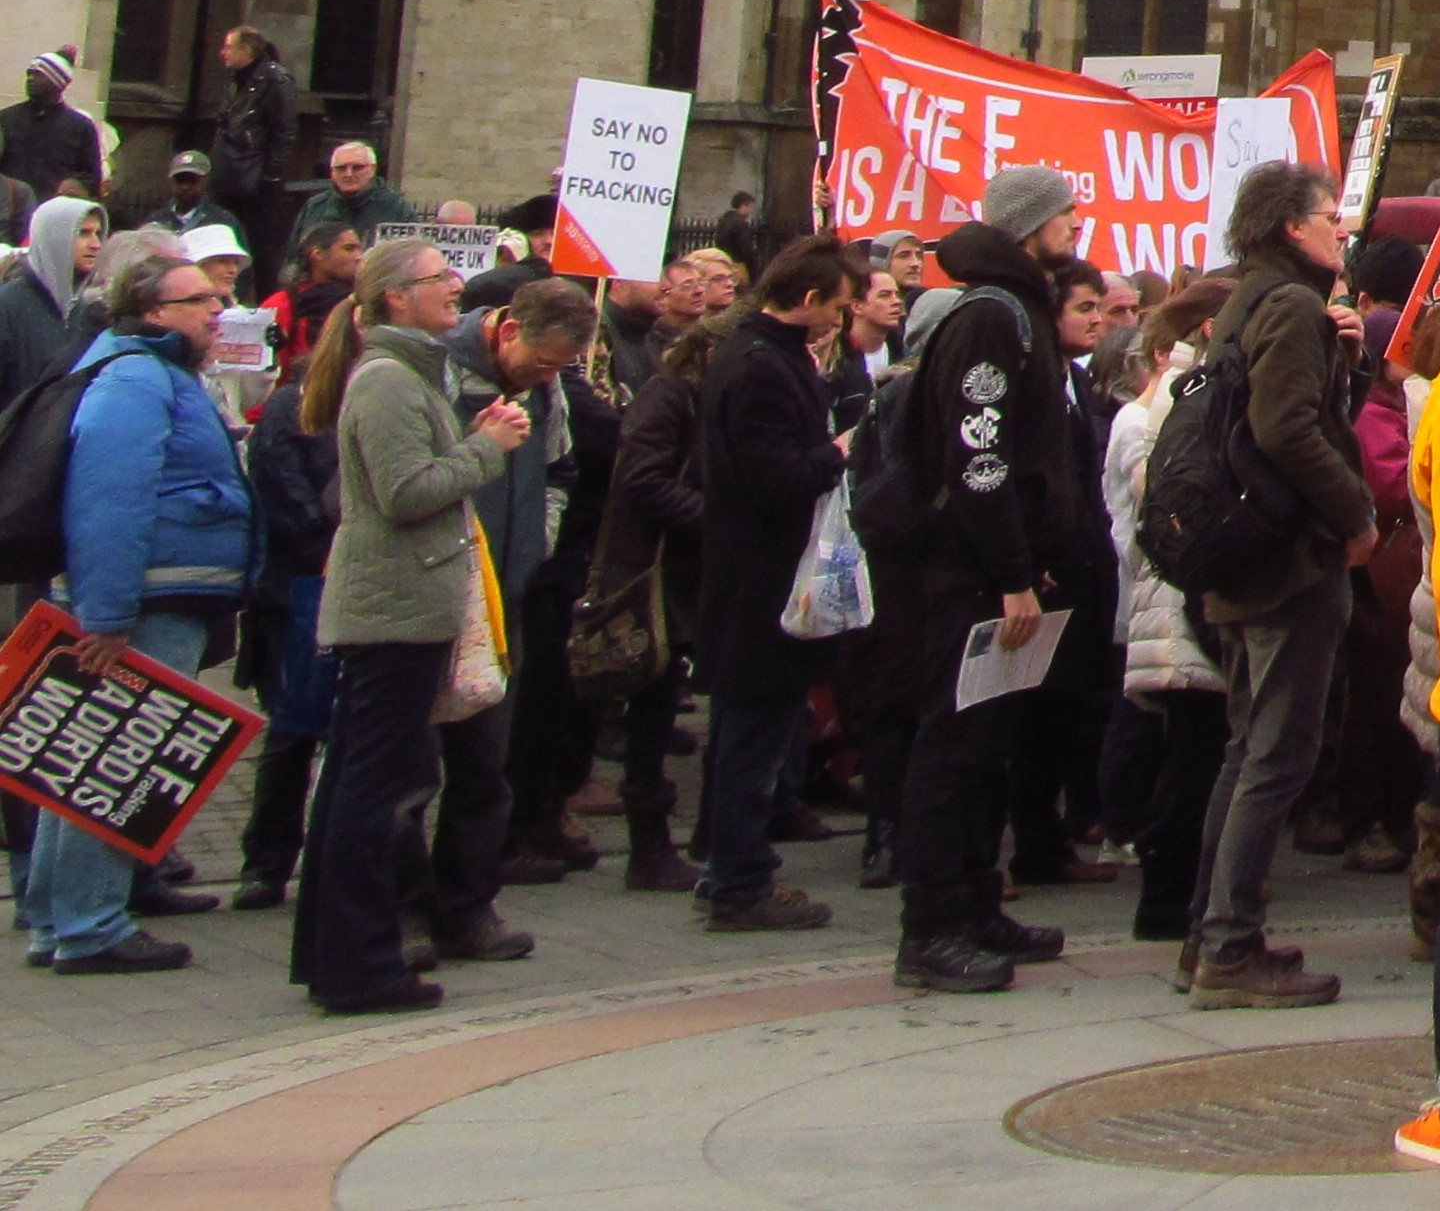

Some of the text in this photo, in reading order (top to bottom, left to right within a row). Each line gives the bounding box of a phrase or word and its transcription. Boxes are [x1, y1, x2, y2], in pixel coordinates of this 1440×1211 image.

[591, 117, 668, 146] SAY NO
[881, 77, 966, 173] THE
[566, 176, 674, 207] FRACKING
[609, 150, 636, 172] TO
[835, 145, 883, 228] IS
[885, 150, 927, 222] A
[467, 250, 485, 269] UK
[0, 677, 84, 773] WORD
[91, 678, 136, 709] A
[33, 701, 121, 798] DIRTY
[71, 689, 190, 817] WORD IS
[162, 708, 233, 771] THE
